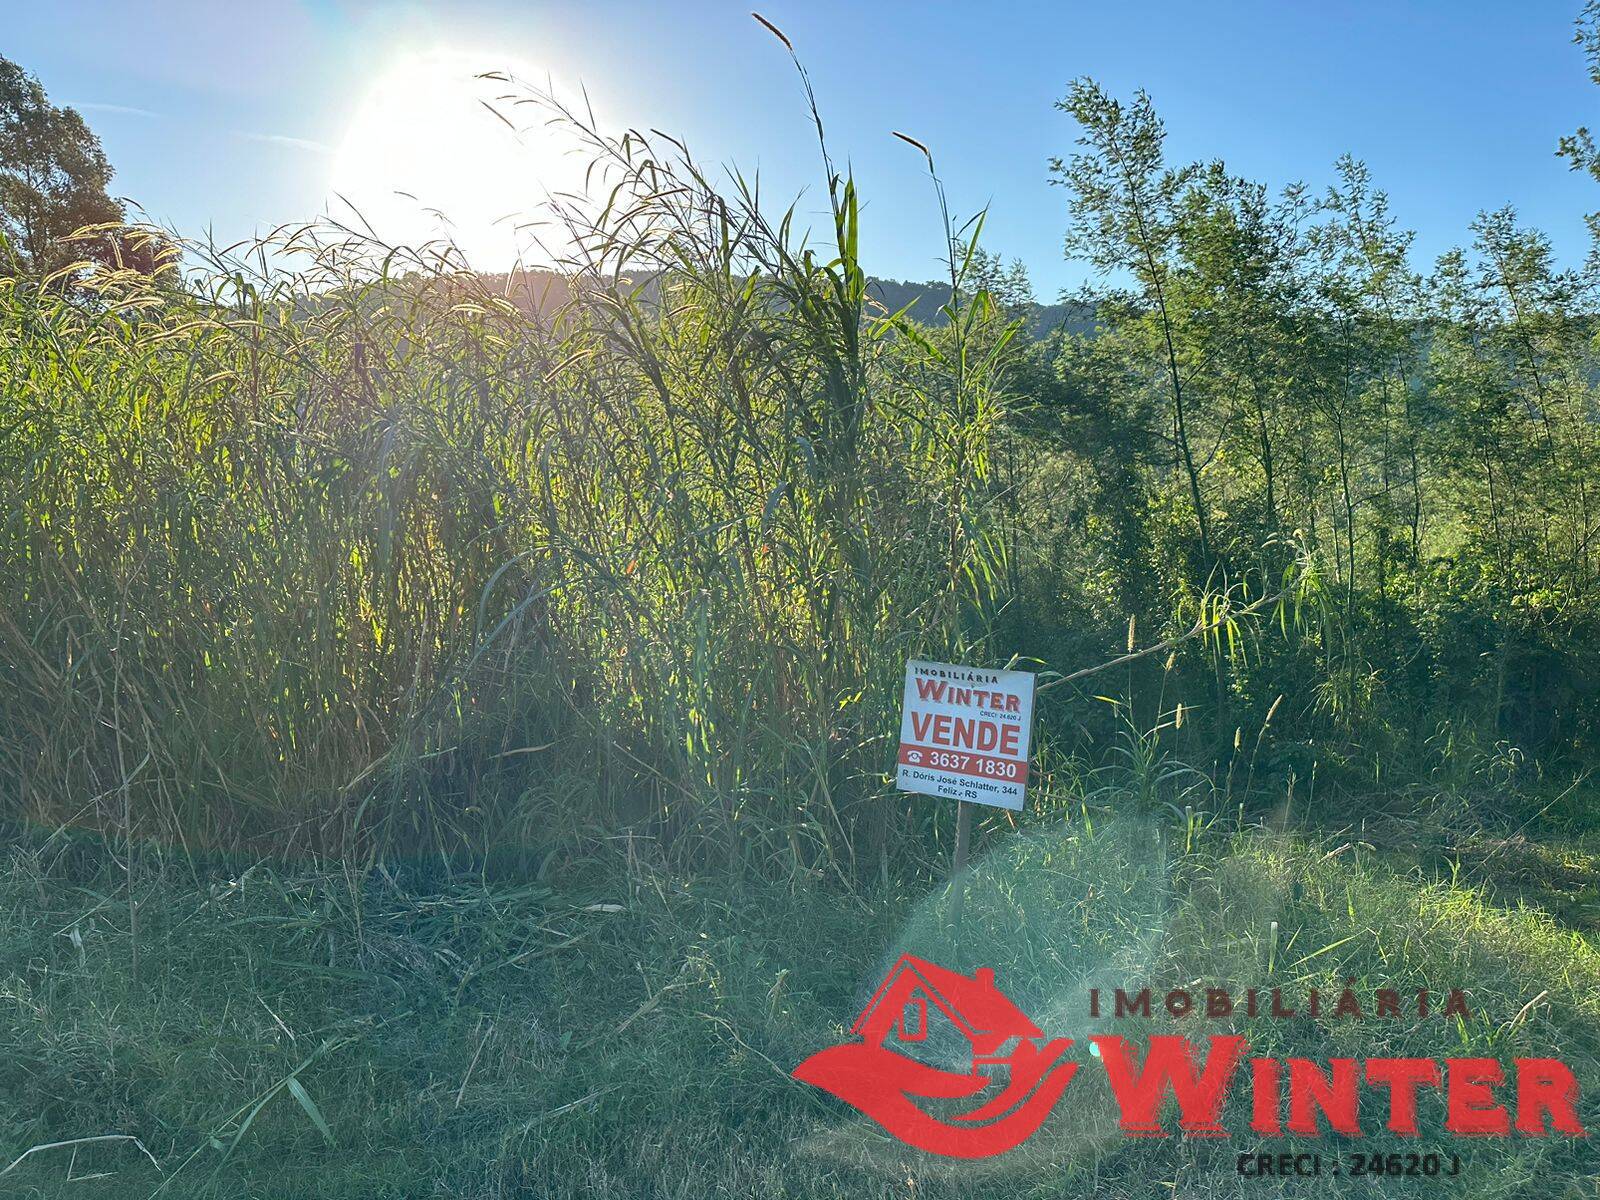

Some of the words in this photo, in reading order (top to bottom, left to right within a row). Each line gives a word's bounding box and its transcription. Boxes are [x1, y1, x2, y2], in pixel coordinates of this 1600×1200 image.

[915, 667, 998, 684] IMOBILIÁRIA
[916, 677, 1021, 713] WINTER
[911, 711, 1021, 756] VENDE
[930, 751, 970, 770] 3637
[976, 758, 1017, 778] 1830
[902, 769, 911, 778] R.
[937, 774, 957, 786] José
[960, 778, 1000, 794] Schlatter,
[1002, 785, 1018, 796] 344
[938, 785, 957, 796] Feliz
[965, 790, 978, 799] RS
